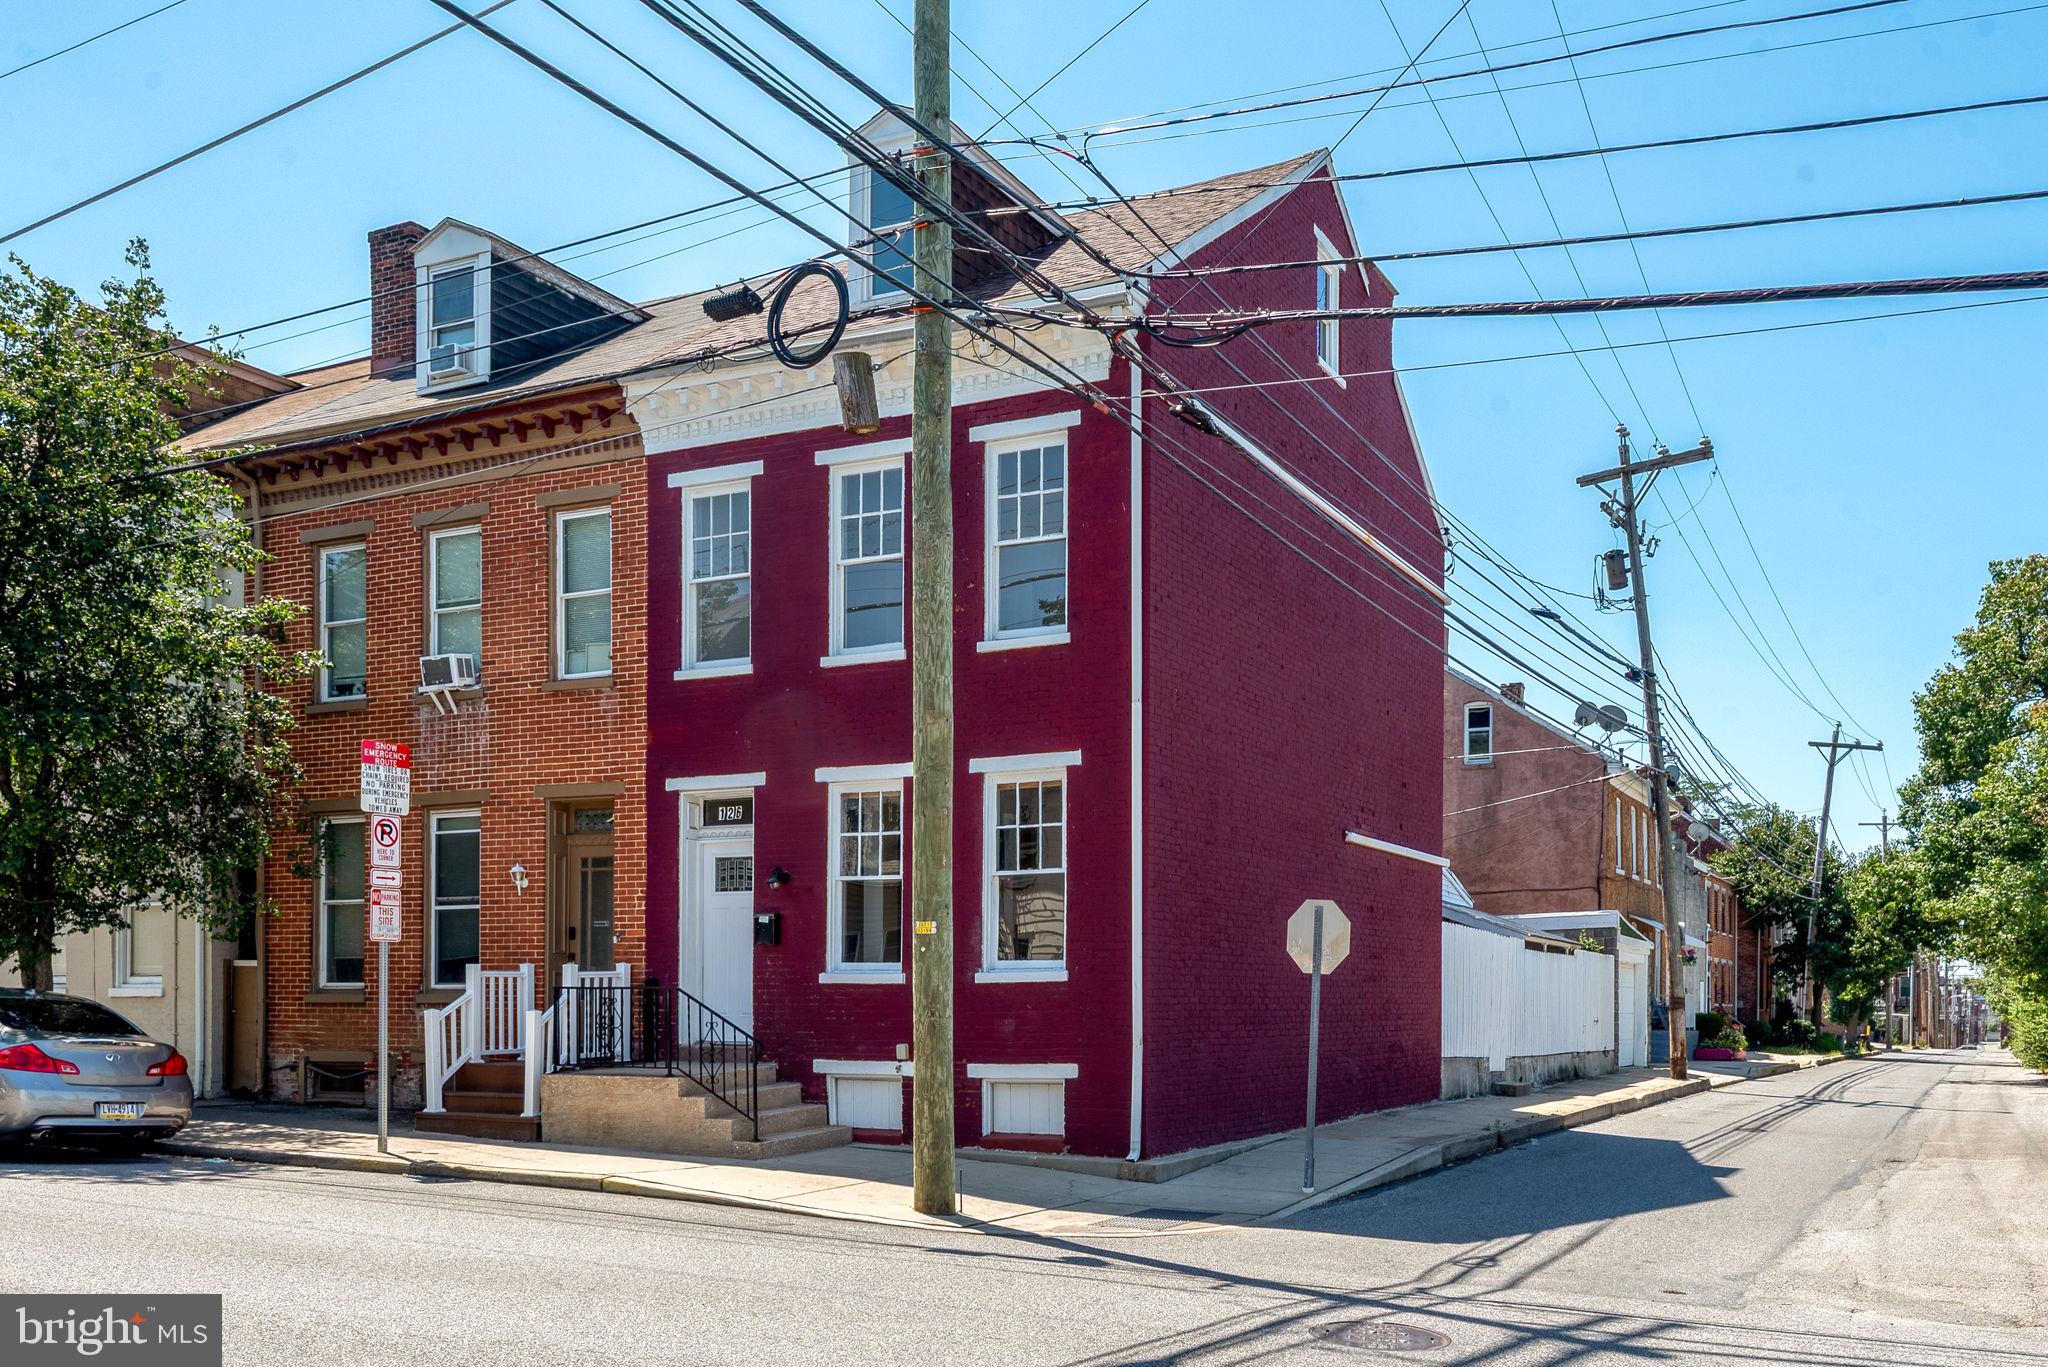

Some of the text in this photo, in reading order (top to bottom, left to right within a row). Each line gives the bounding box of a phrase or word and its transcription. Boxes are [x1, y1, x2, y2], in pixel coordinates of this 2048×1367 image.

[375, 742, 398, 751] SNOW
[364, 748, 407, 761] EMERGENCY
[375, 757, 398, 767] ROUTE
[364, 764, 380, 772] SNOW
[383, 766, 398, 774] TIRES
[362, 771, 409, 784] CHAINS REQUIRED
[366, 780, 406, 791] NO PARKING
[362, 787, 409, 800] DURING EMERGENCY
[374, 797, 398, 806] VEHICLES
[368, 804, 403, 814] TOWED AWAY
[719, 806, 742, 820] 126
[372, 892, 380, 902] NO
[378, 907, 394, 916] THIS
[378, 916, 394, 925] SIDE
